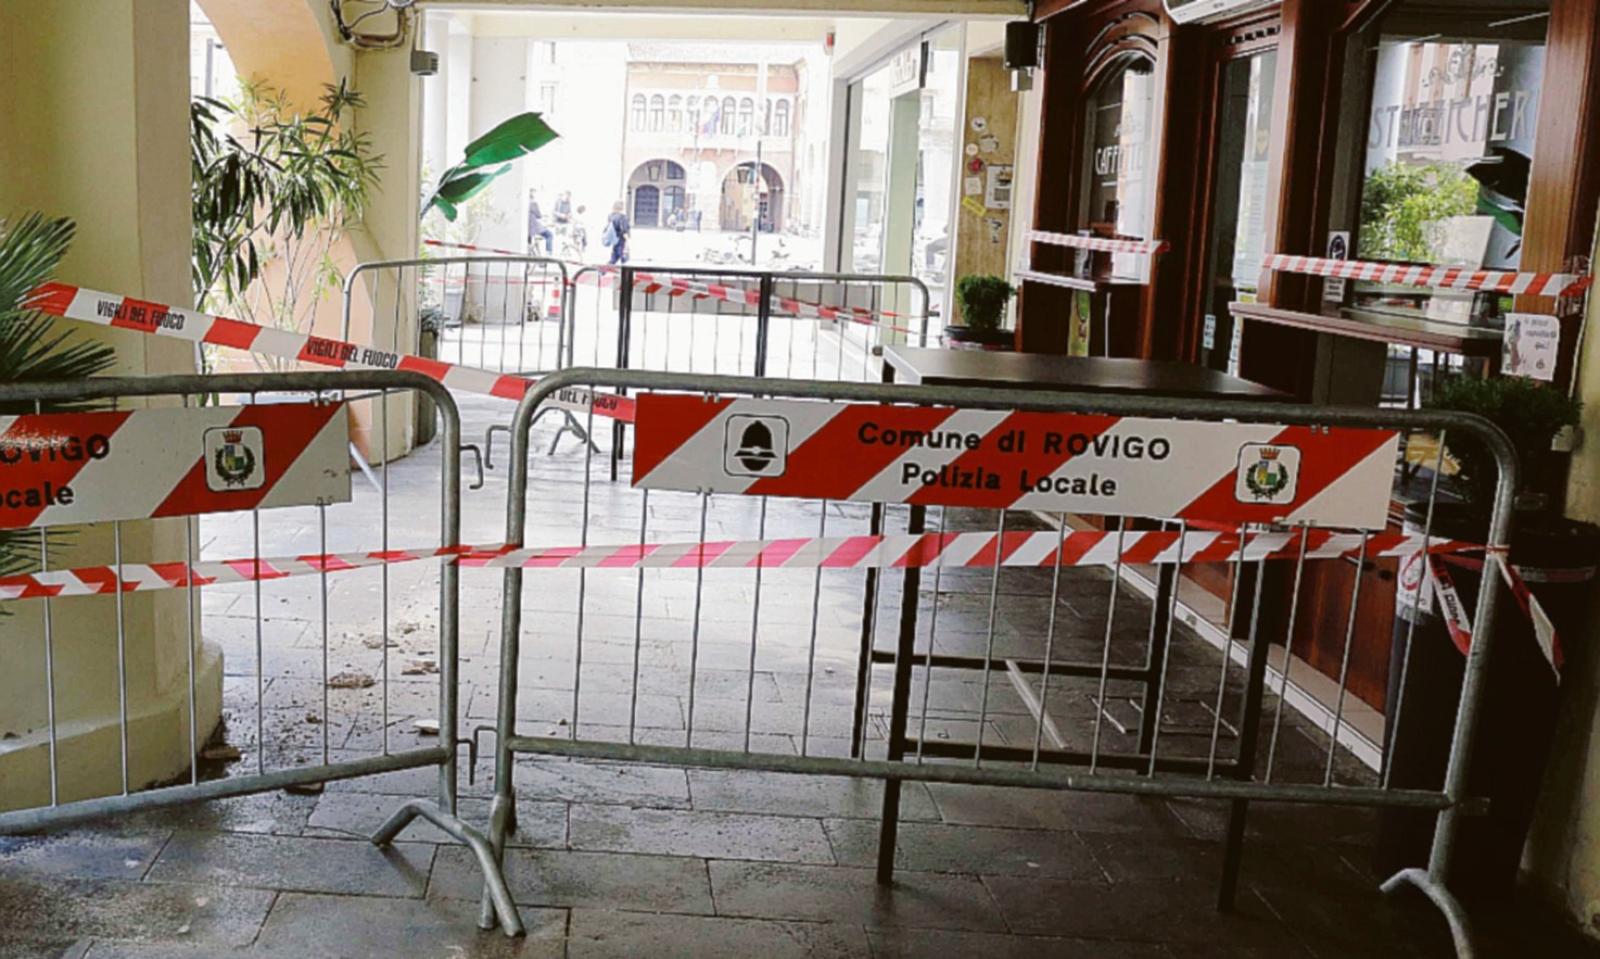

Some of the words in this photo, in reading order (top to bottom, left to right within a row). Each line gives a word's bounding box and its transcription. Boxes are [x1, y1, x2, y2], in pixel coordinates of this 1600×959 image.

[97, 299, 128, 320] VIGILI
[128, 306, 147, 324] DEL
[150, 311, 185, 330] FUOCO
[307, 338, 337, 358] VIGILI
[341, 345, 359, 363] DEL
[361, 348, 398, 368] FUOCO
[857, 422, 982, 449] Comune
[997, 430, 1025, 452] di
[1043, 432, 1171, 460] ROVIGO
[0, 481, 74, 509] cale
[901, 463, 1001, 490] Polizia
[1019, 470, 1117, 496] Locale
